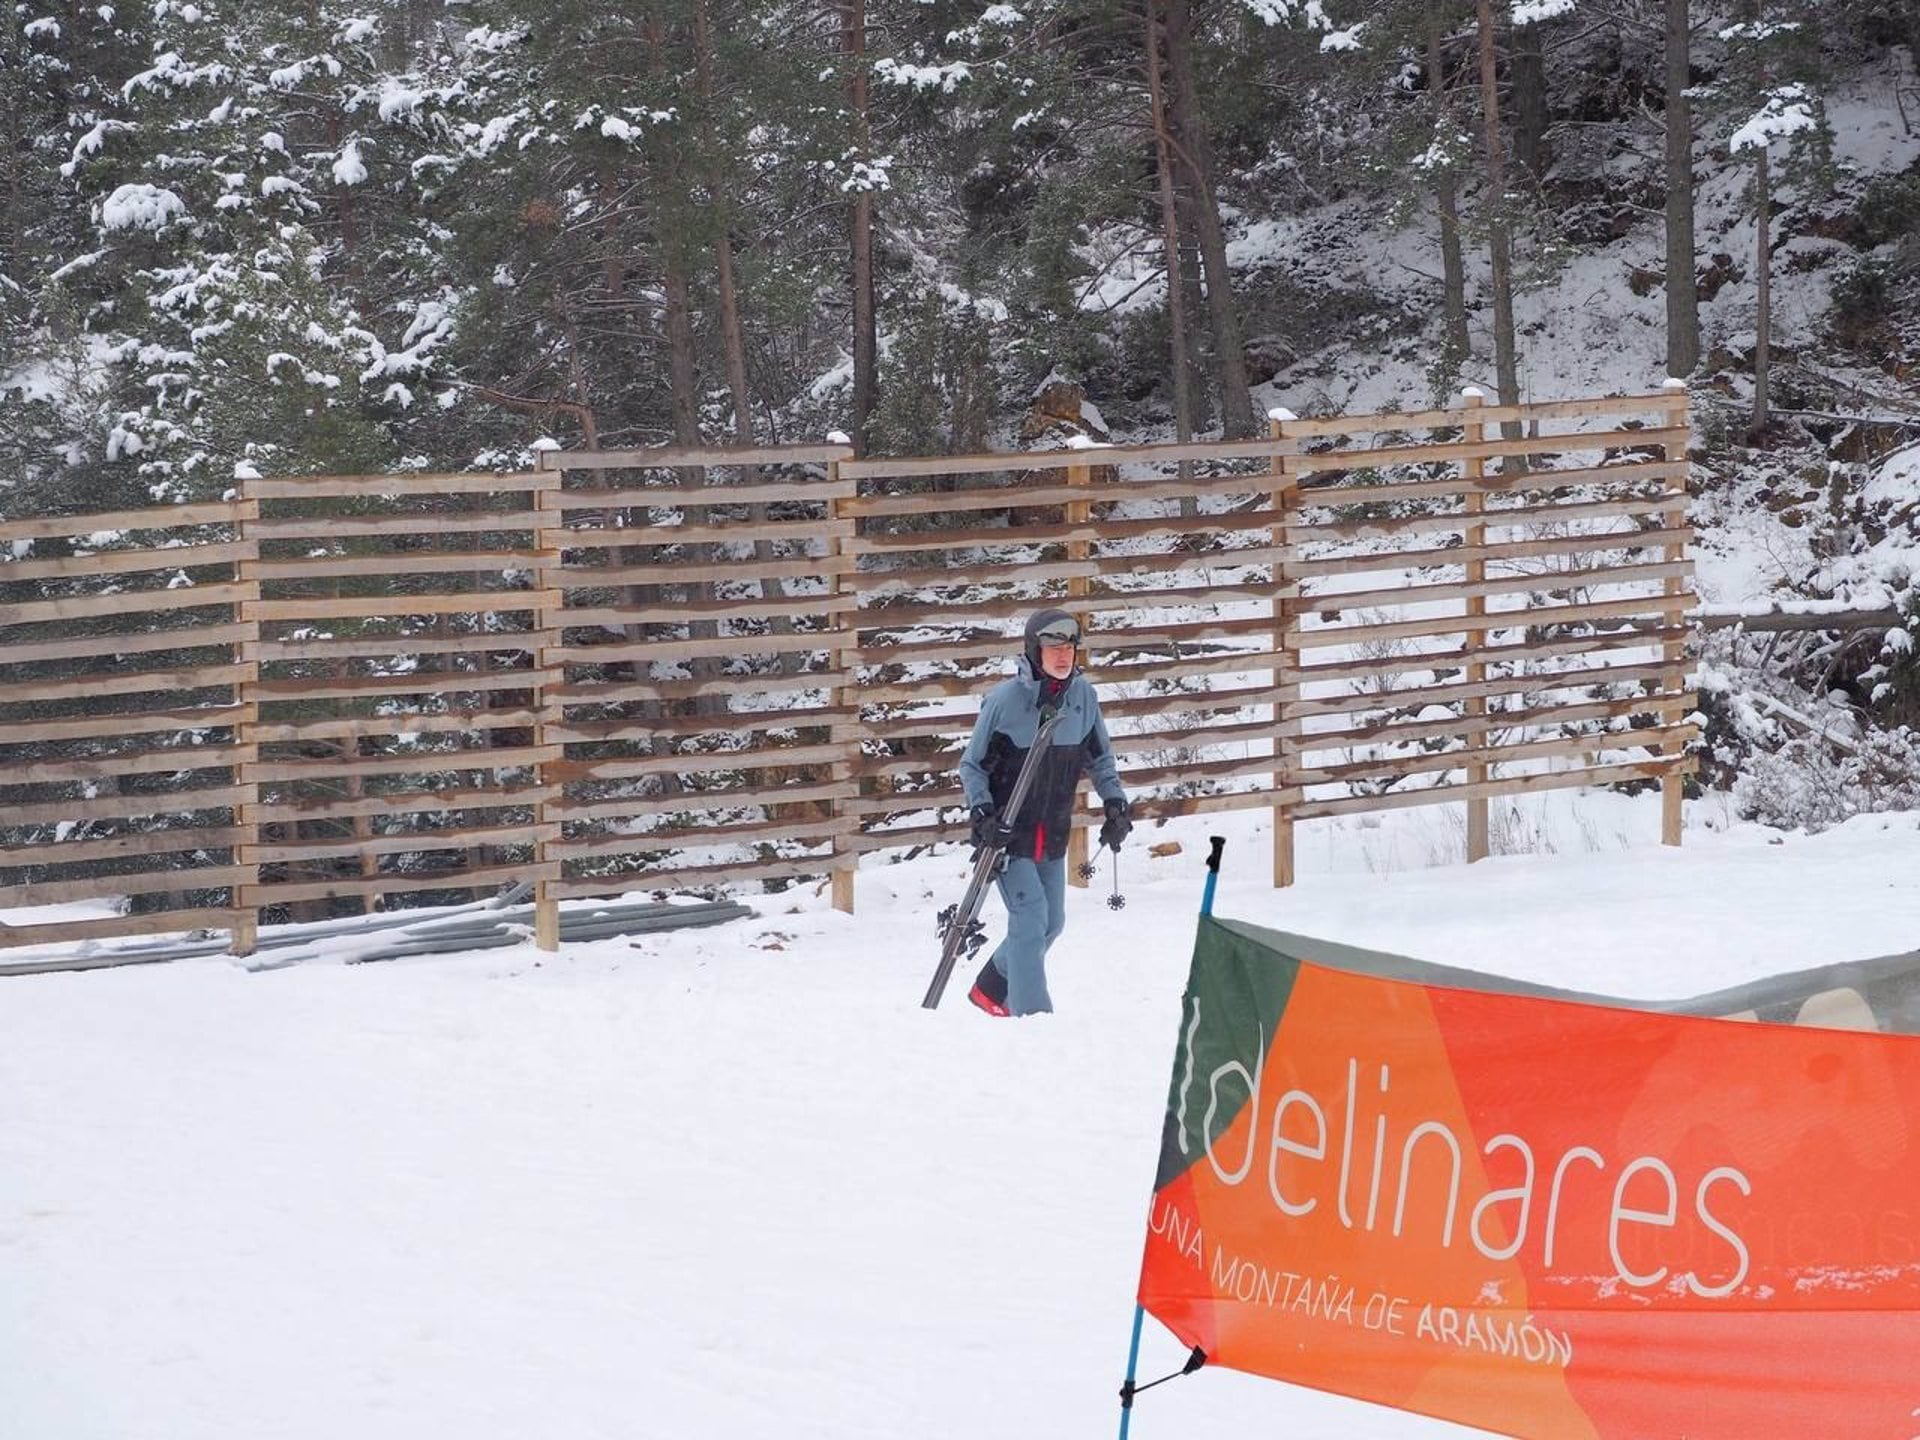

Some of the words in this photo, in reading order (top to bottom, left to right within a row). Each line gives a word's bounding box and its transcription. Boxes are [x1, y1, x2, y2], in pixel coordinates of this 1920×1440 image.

[1147, 1192, 1203, 1271] UNA
[1211, 1245, 1353, 1325] MONTAÑA
[1363, 1294, 1409, 1335] DE
[1416, 1302, 1573, 1368] ARAMÓN
